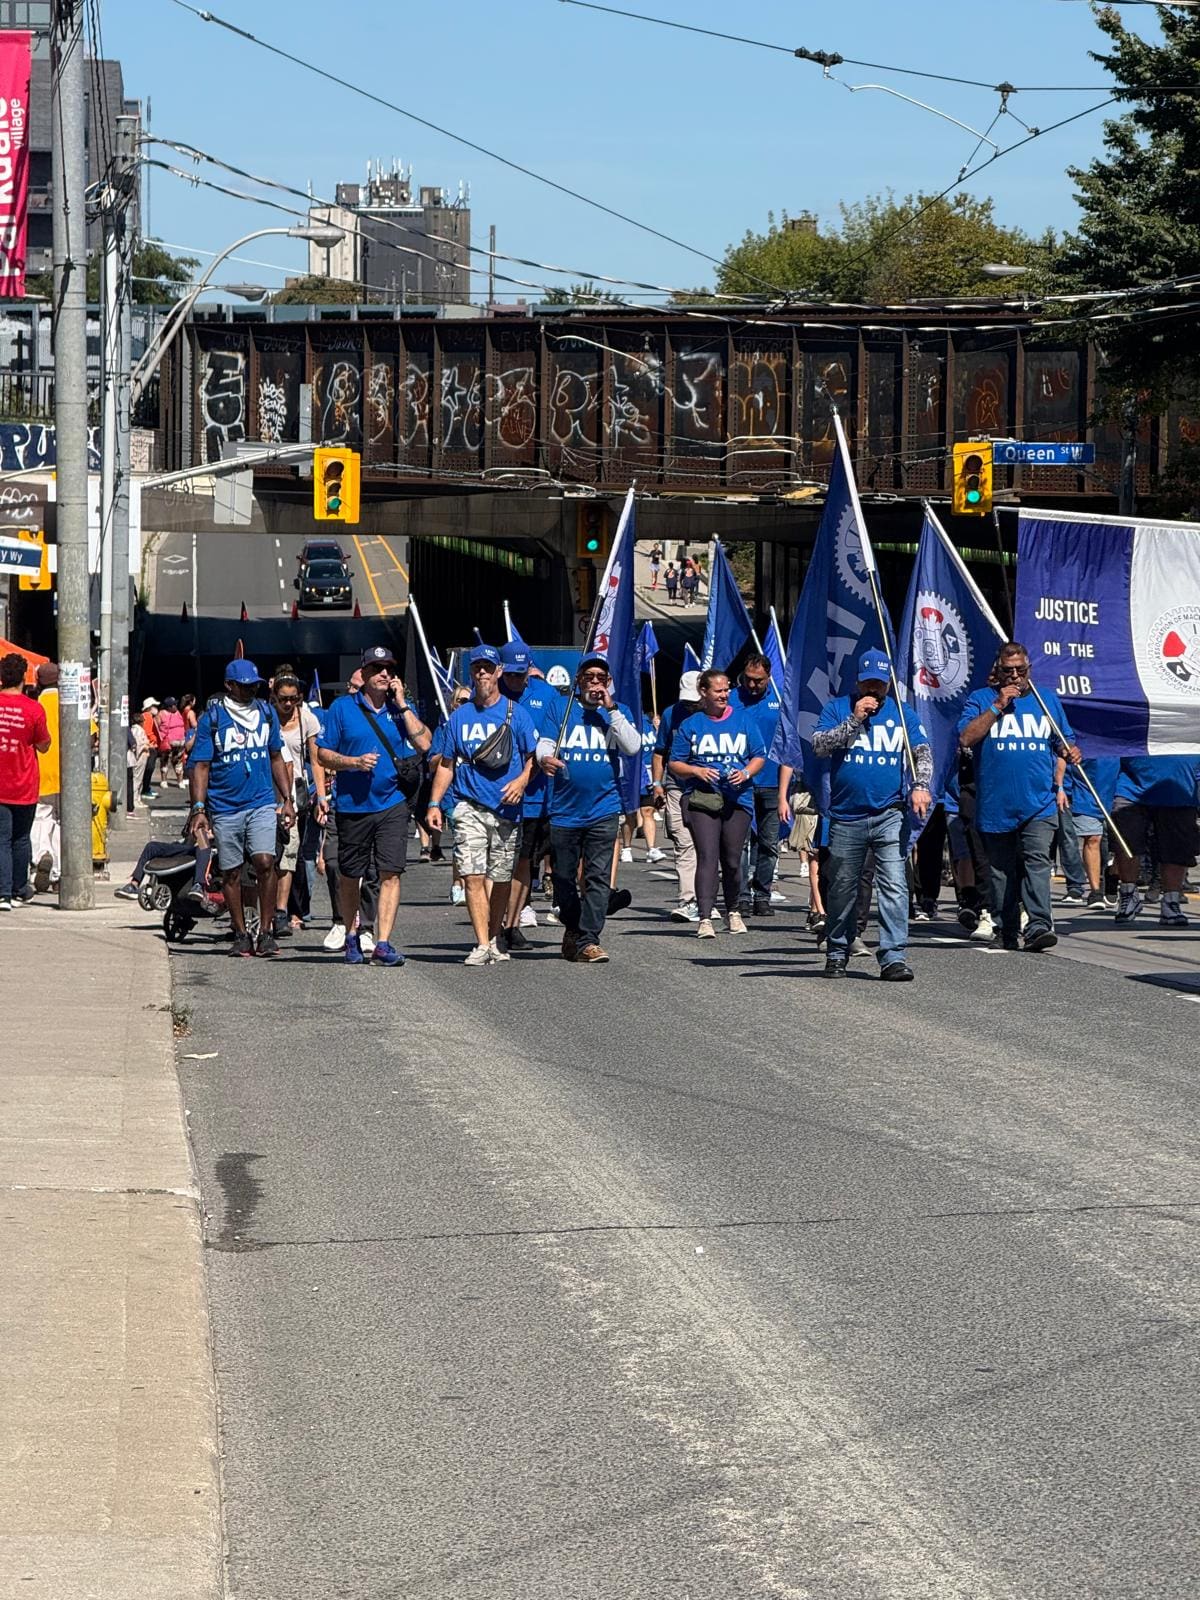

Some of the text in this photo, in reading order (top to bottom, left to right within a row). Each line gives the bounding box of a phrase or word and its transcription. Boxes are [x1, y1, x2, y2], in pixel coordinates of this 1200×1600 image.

[10, 98, 25, 150] village
[1005, 446, 1083, 461] Queen St W
[10, 551, 23, 564] Wy
[1035, 597, 1099, 625] JUSTICE
[1044, 641, 1094, 658] ON THE
[1056, 674, 1092, 695] JOB
[529, 699, 543, 707] IAM
[990, 713, 1052, 740] IAM
[849, 725, 905, 752] AM
[996, 742, 1046, 751] UNION
[564, 752, 610, 763] UNION
[844, 754, 898, 766] UNION
